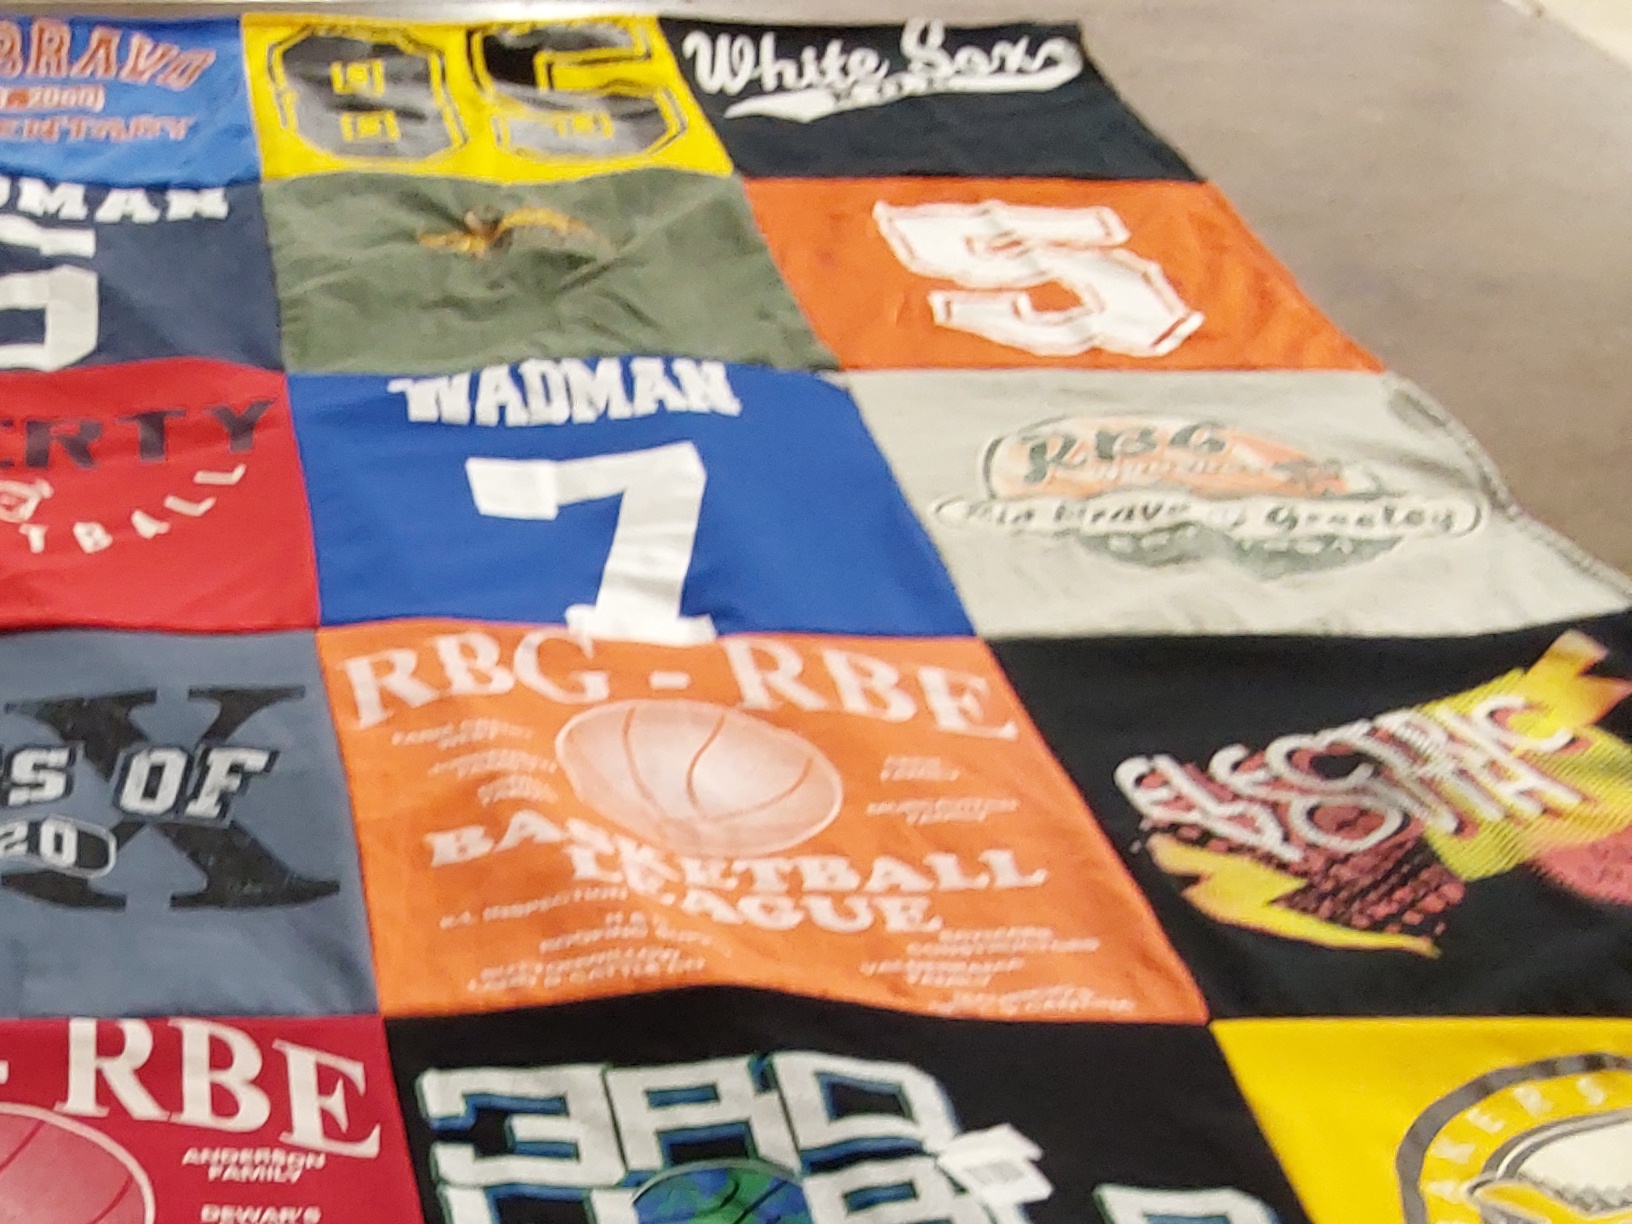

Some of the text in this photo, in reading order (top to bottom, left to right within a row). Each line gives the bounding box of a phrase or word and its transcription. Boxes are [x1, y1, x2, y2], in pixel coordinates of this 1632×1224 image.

[682, 31, 889, 95] White
[900, 17, 1053, 82] Sox
[872, 199, 1206, 357] 5
[386, 357, 742, 428] WADMAN
[466, 441, 717, 646] 7
[337, 628, 609, 729] RBG
[724, 637, 1018, 740] RBE
[117, 744, 276, 823] OF
[54, 1017, 380, 1158] RBE
[208, 1164, 303, 1184] FAMILY
